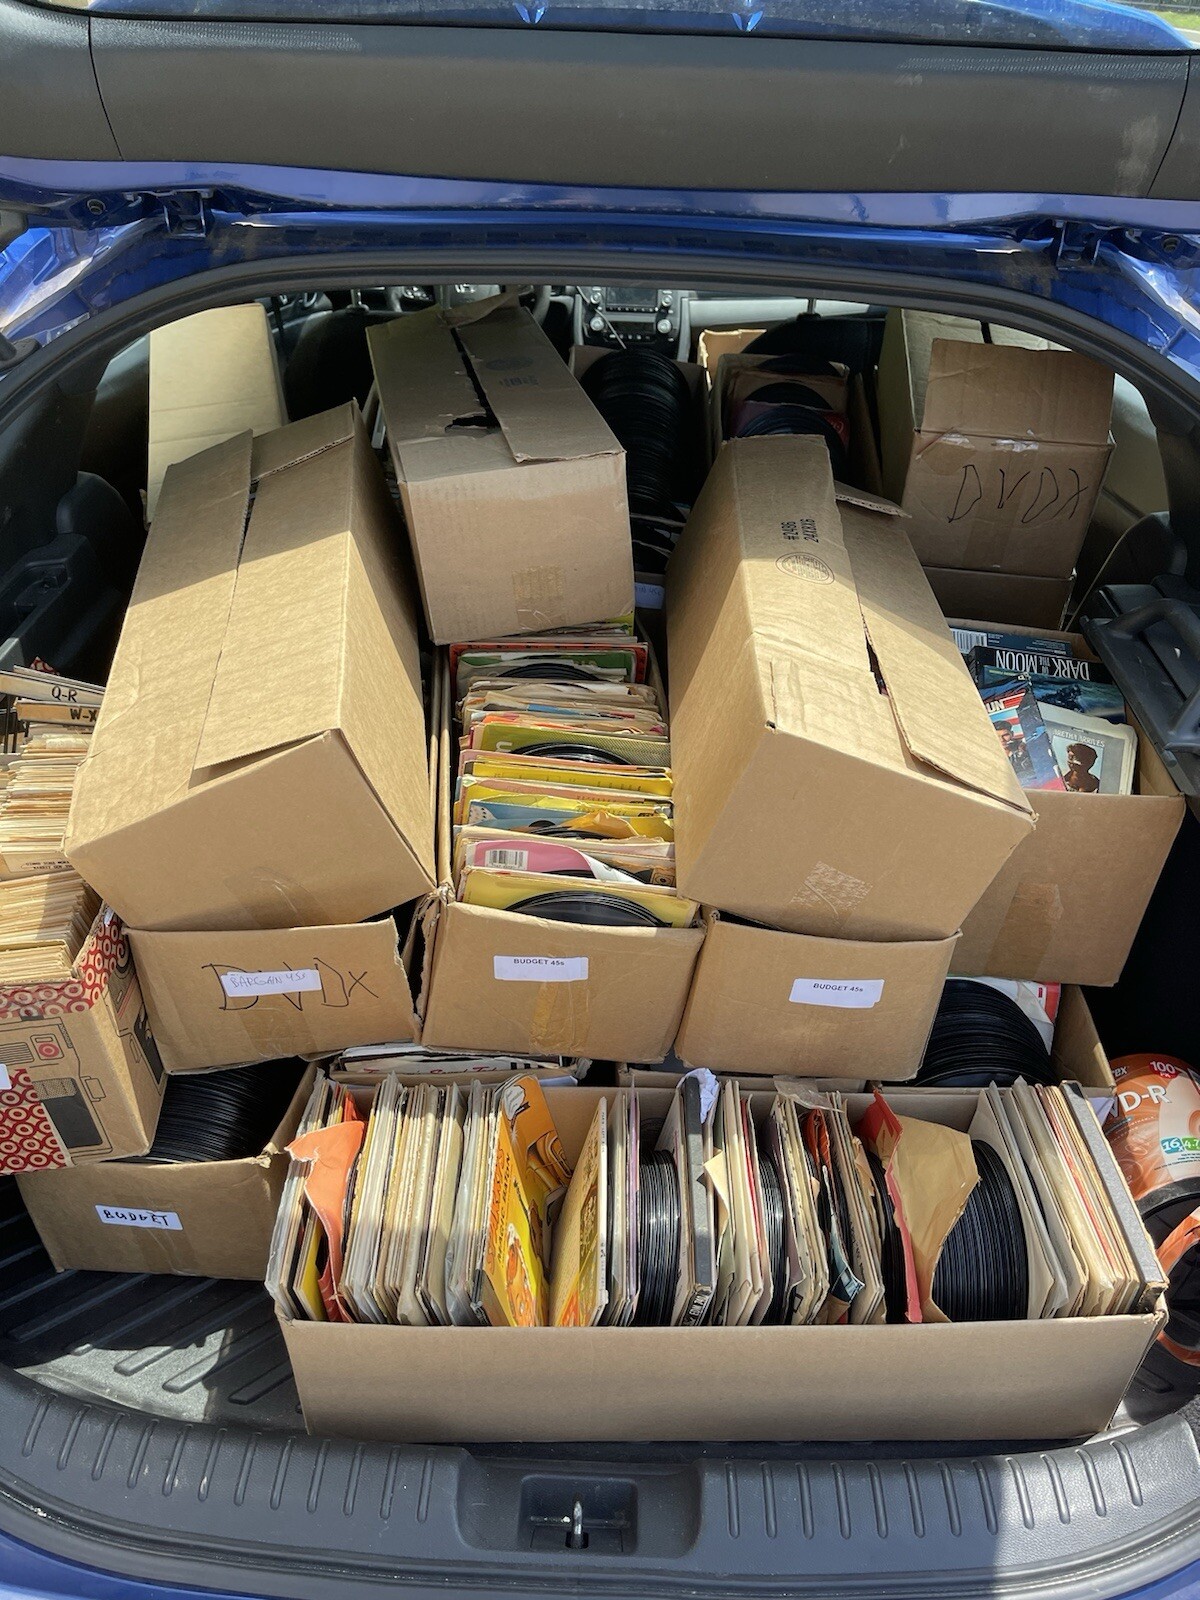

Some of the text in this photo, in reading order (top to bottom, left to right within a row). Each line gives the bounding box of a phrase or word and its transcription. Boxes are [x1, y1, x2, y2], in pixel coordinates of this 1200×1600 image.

[995, 650, 1037, 674] MOON
[1051, 657, 1090, 681] DARK
[52, 685, 77, 702] Q-R
[986, 700, 1005, 713] UN
[1053, 729, 1105, 747] ARETHA ARRIVES
[230, 973, 283, 989] BARGAIN
[813, 982, 848, 991] BUDGET
[1149, 1061, 1176, 1074] 100
[103, 1209, 169, 1226] BUDGET
